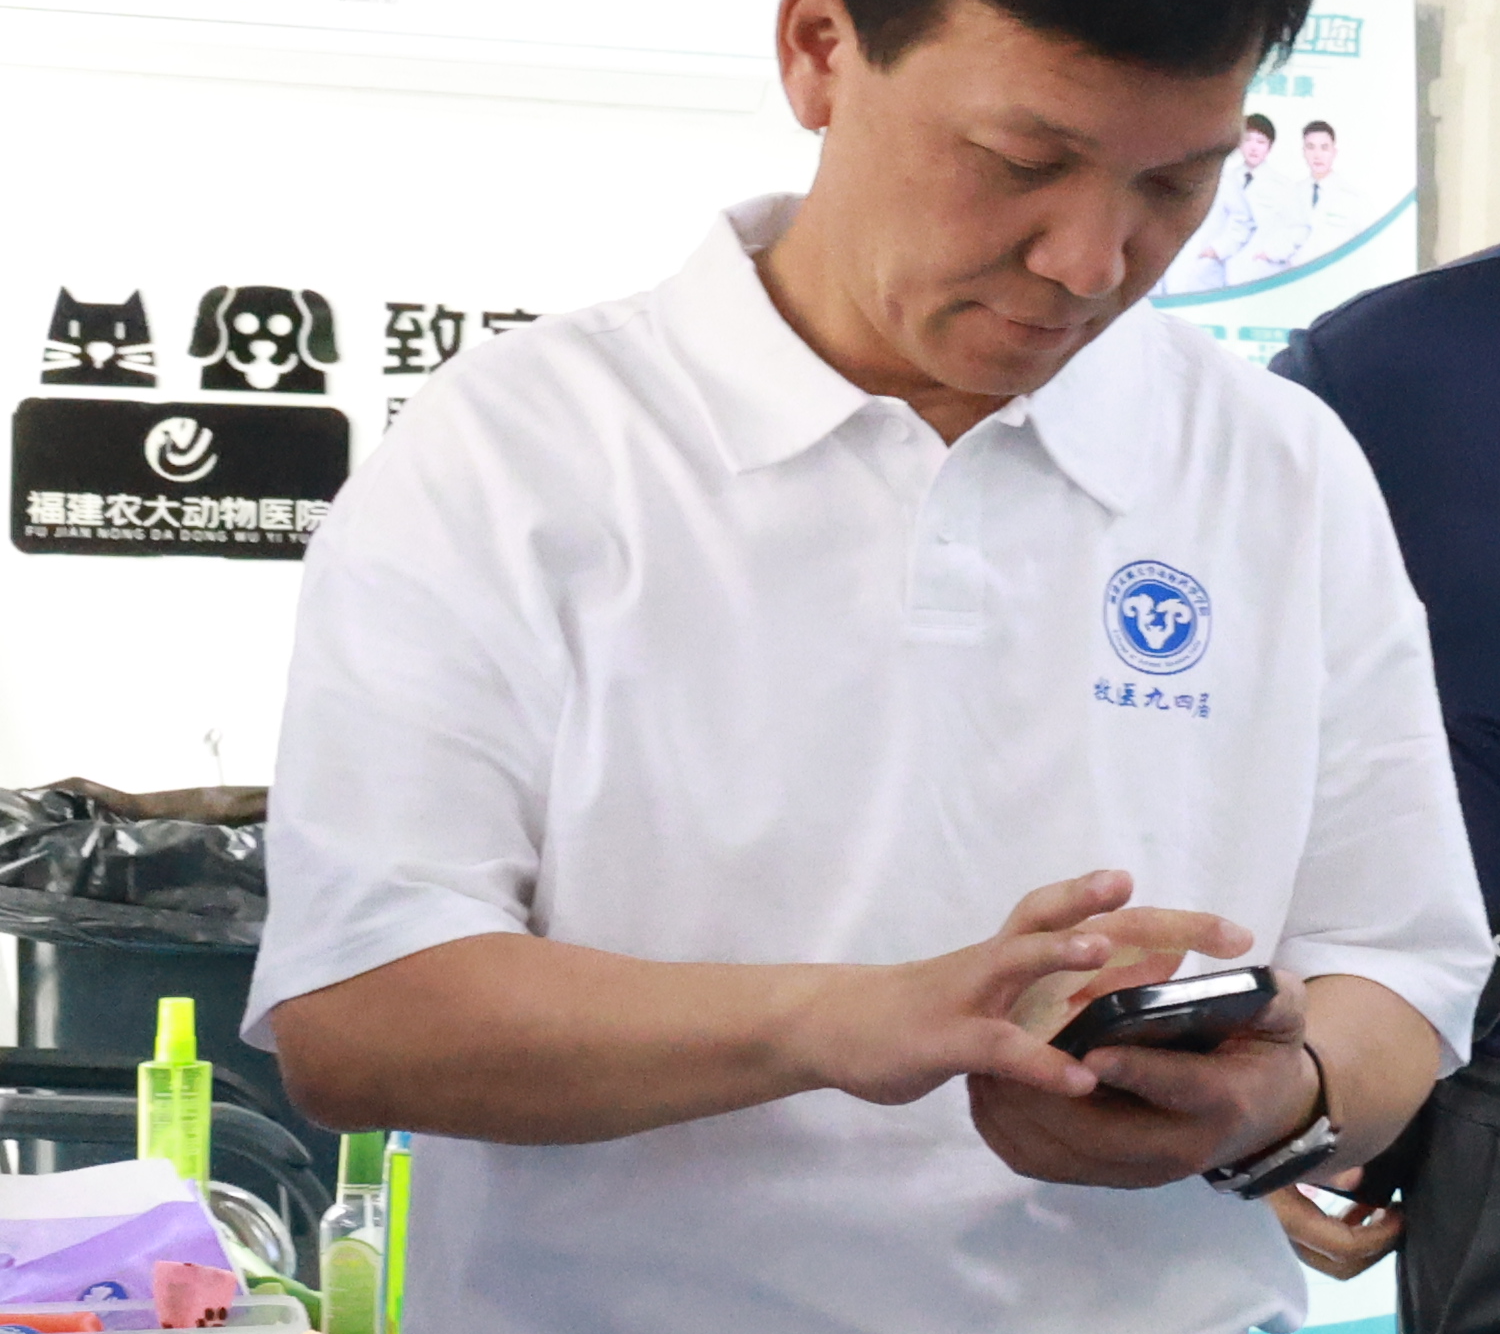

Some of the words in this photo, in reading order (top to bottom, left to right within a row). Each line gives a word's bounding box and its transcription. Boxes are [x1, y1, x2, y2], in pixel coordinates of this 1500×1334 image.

[25, 490, 331, 532] 福建农大动物医院
[96, 528, 146, 541] NONG
[179, 530, 228, 543] DONG
